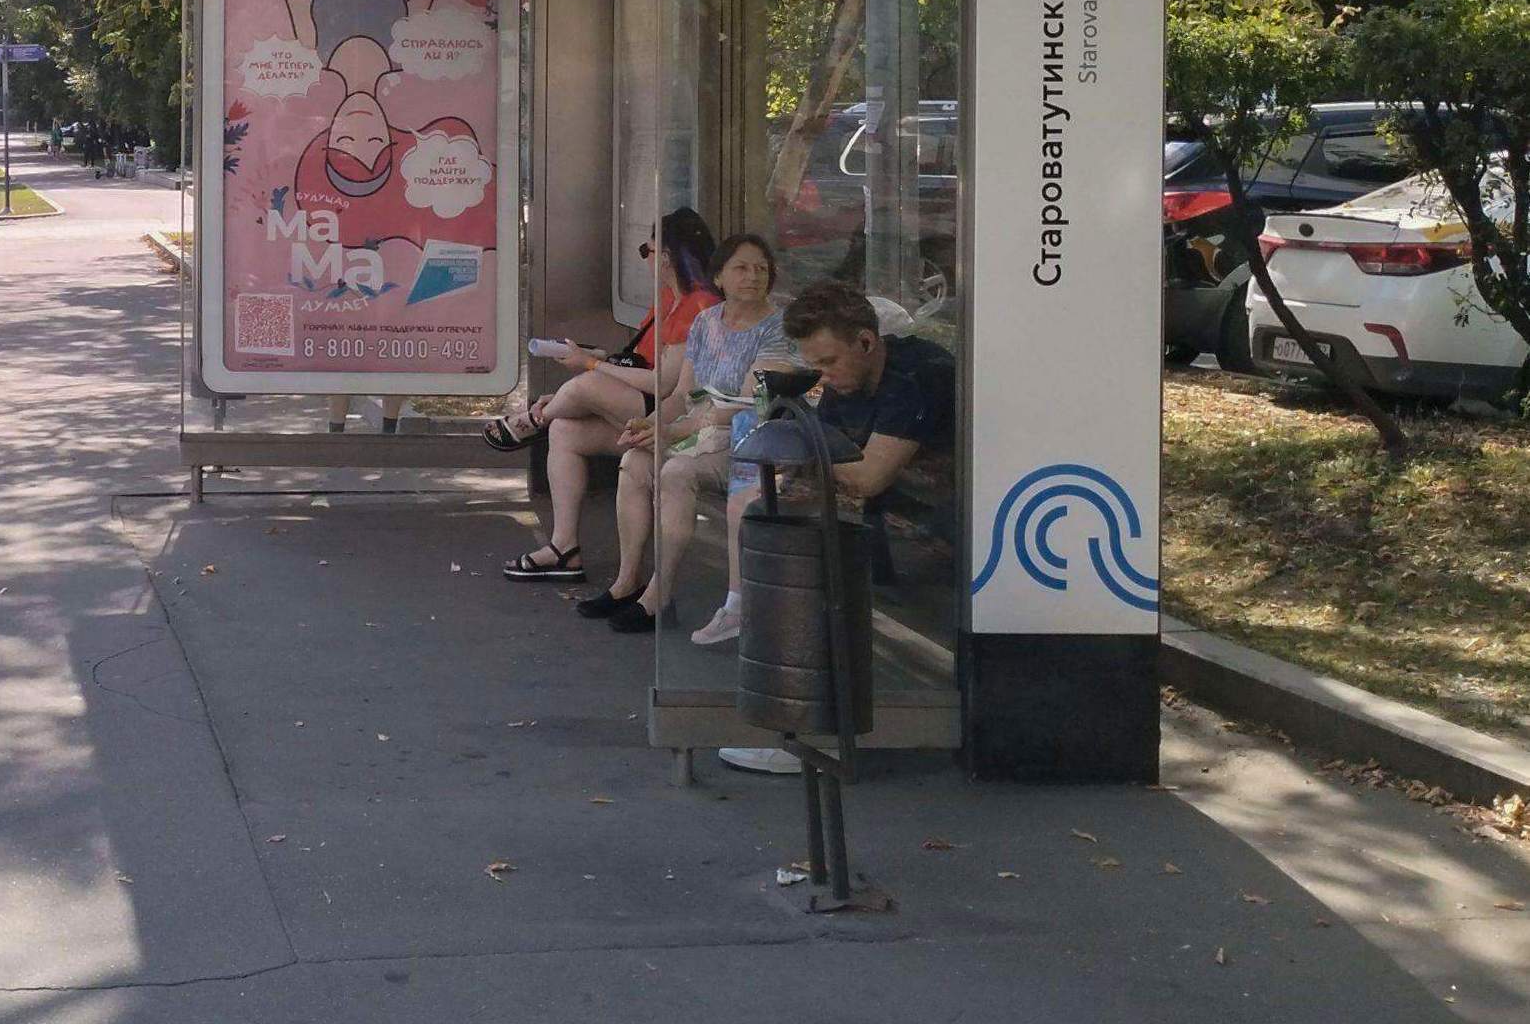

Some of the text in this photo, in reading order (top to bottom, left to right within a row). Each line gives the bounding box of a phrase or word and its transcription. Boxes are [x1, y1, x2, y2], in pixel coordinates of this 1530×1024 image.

[271, 50, 293, 60] ЧТО
[438, 156, 458, 166] ГДЕ
[303, 338, 479, 360] 8-800-2000-492
